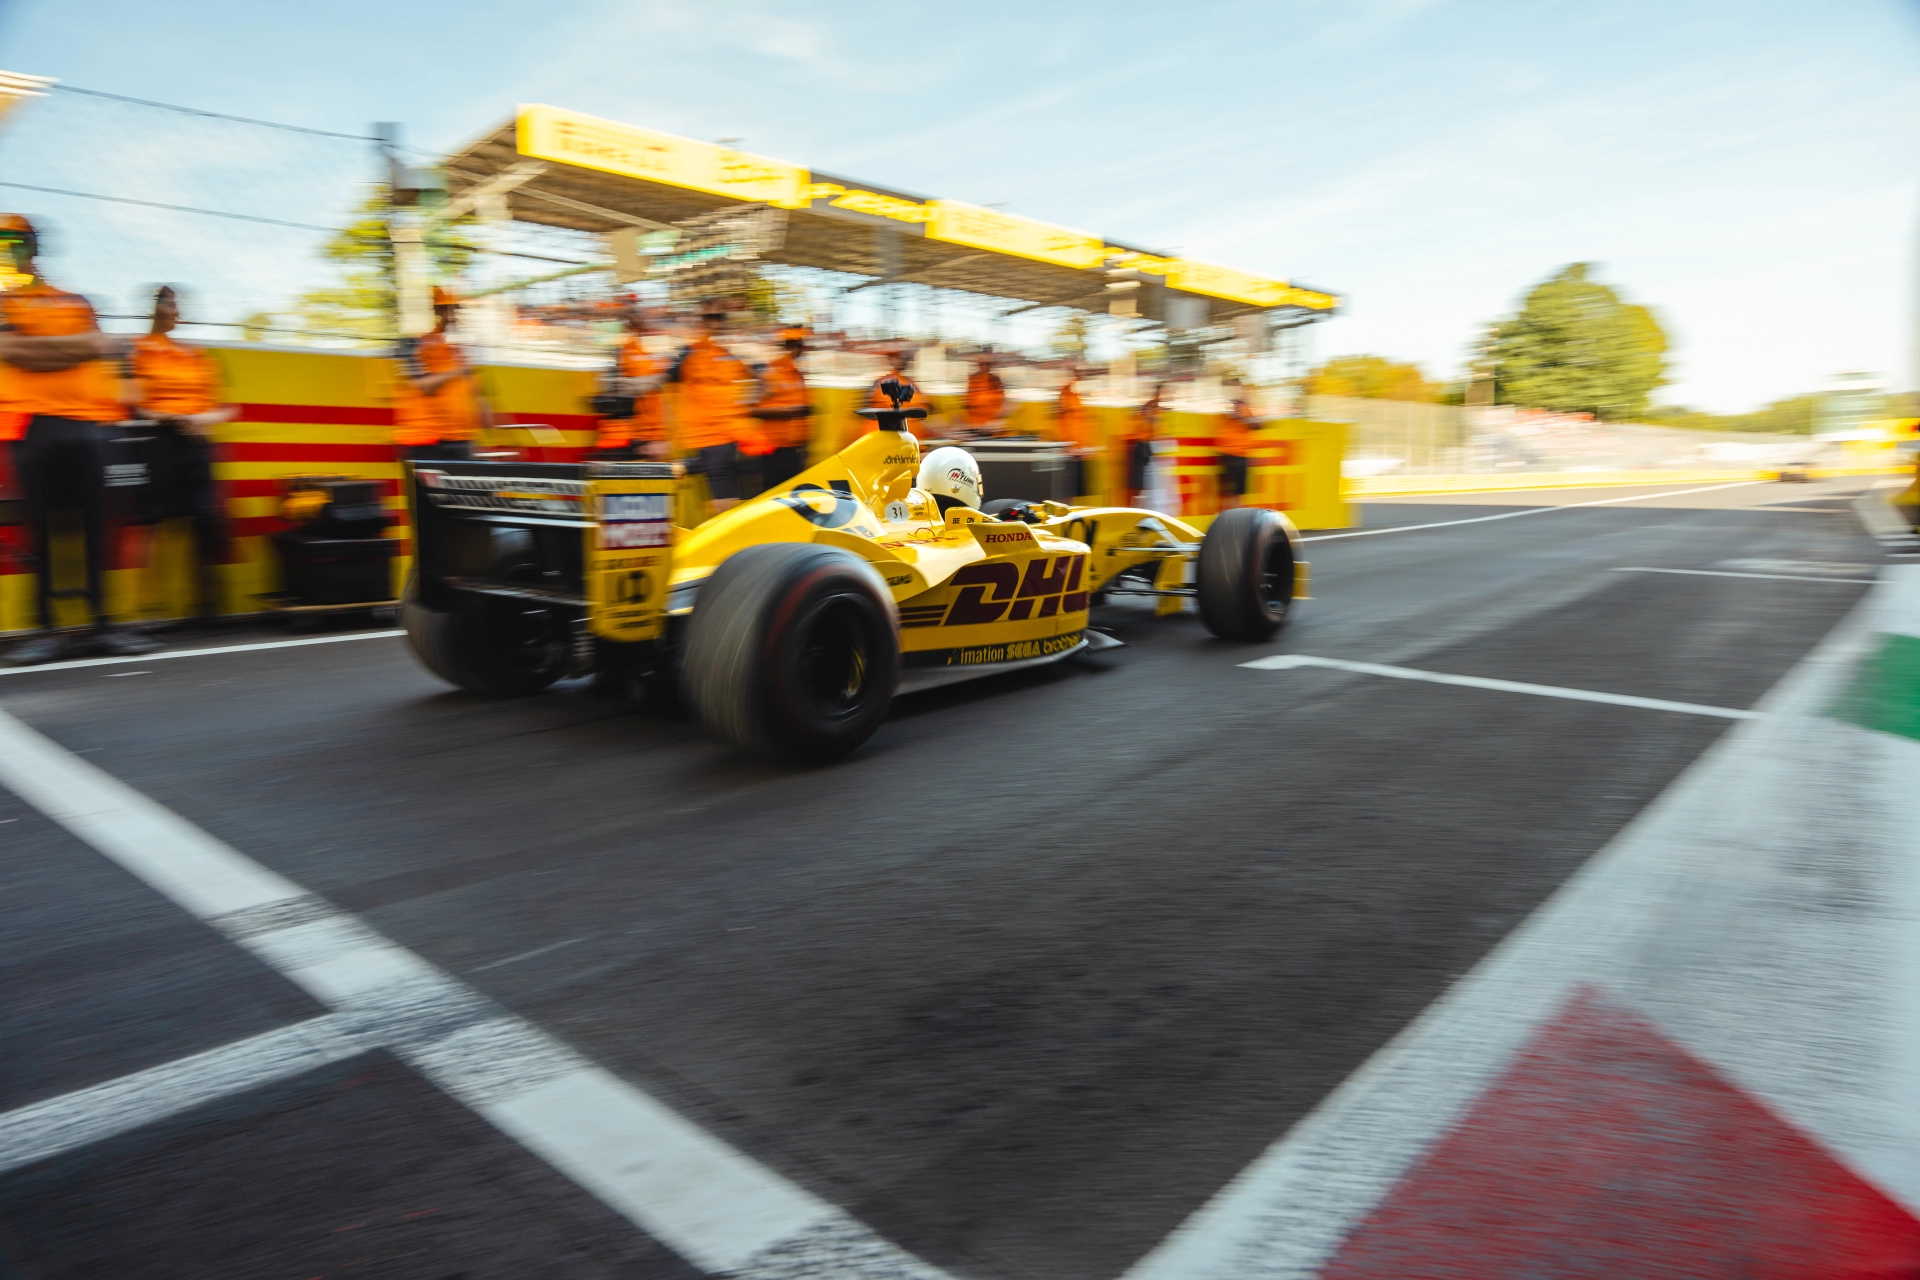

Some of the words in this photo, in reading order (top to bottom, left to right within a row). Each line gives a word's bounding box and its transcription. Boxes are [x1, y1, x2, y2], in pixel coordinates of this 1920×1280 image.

[892, 506, 903, 519] 31
[985, 532, 1033, 543] HONDA
[943, 554, 1088, 627] DHL
[960, 646, 1004, 665] imation
[1006, 641, 1041, 661] SEGA
